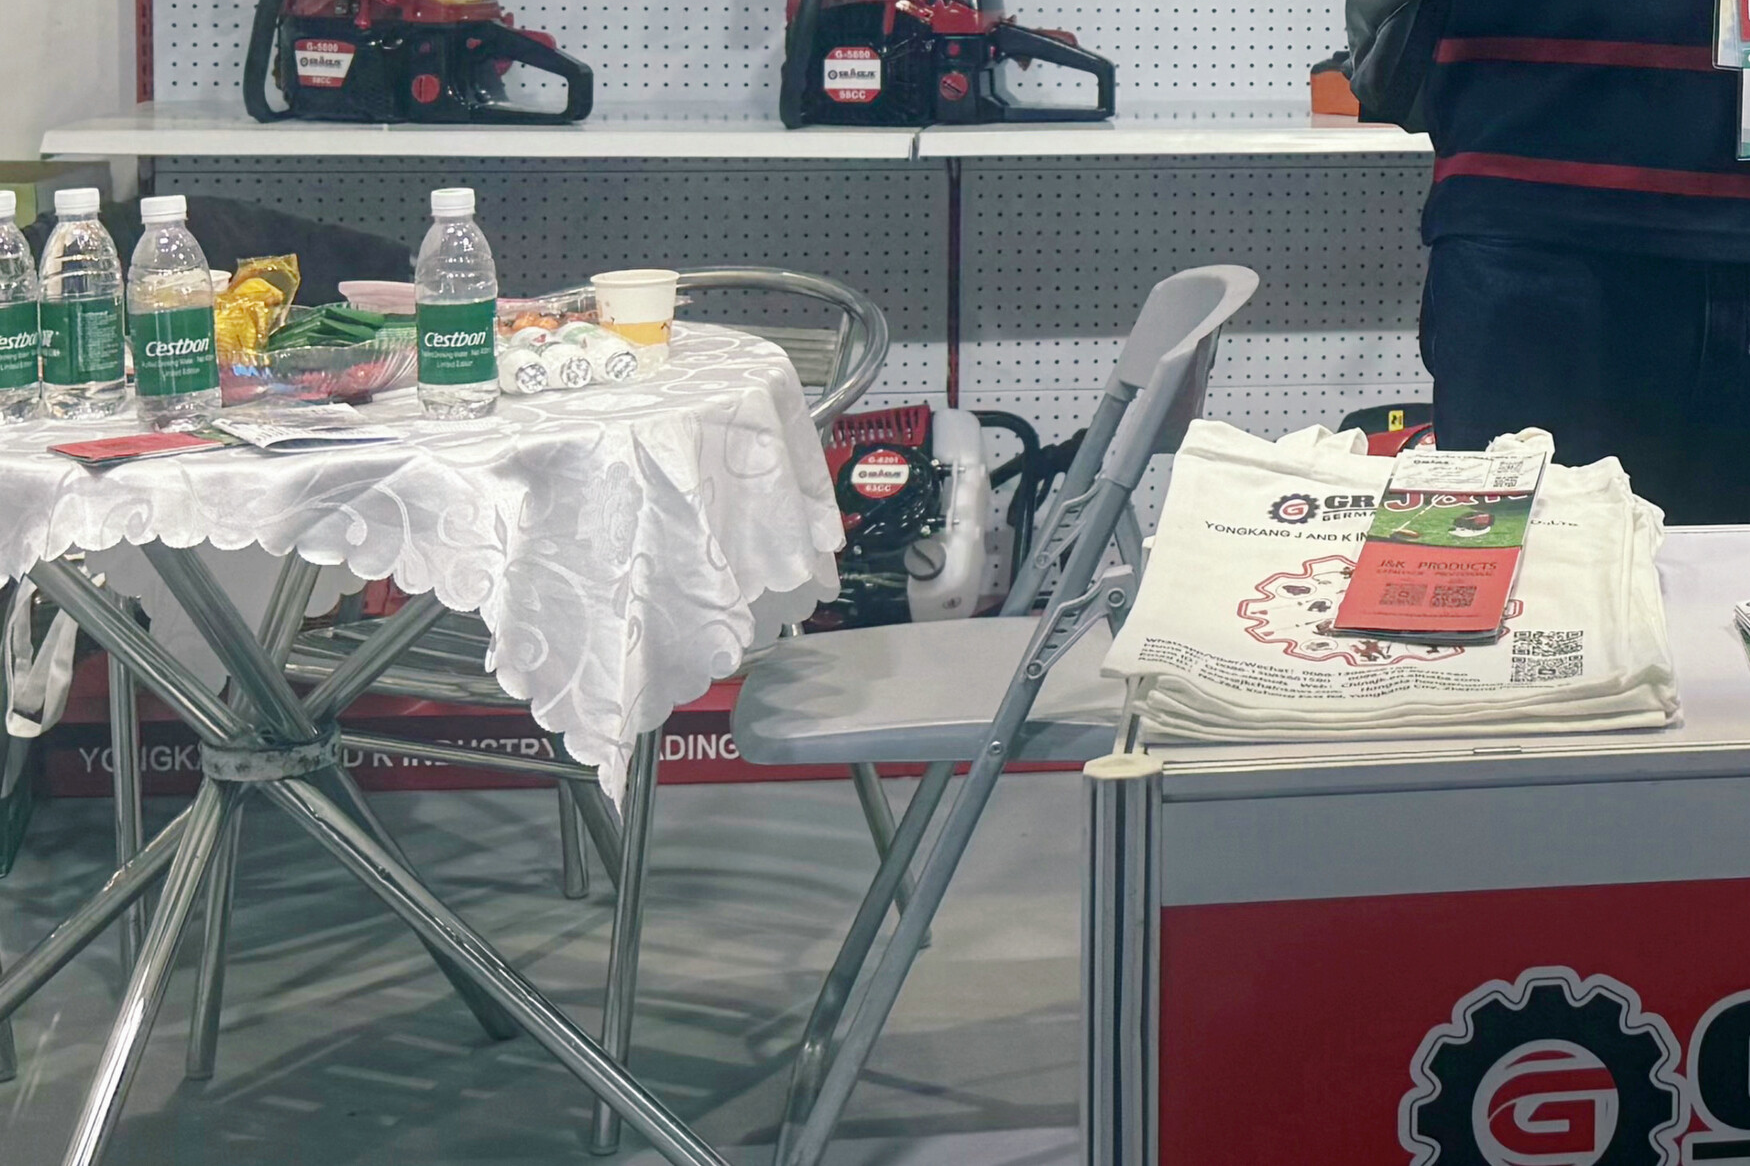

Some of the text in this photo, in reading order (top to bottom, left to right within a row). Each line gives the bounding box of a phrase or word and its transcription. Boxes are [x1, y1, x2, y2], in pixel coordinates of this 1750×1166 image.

[1322, 512, 1377, 522] GERMA
[1205, 520, 1290, 538] YONGKANG
[1306, 533, 1338, 542] AND
[1341, 533, 1352, 542] K
[1418, 561, 1498, 571] PRODUCTS
